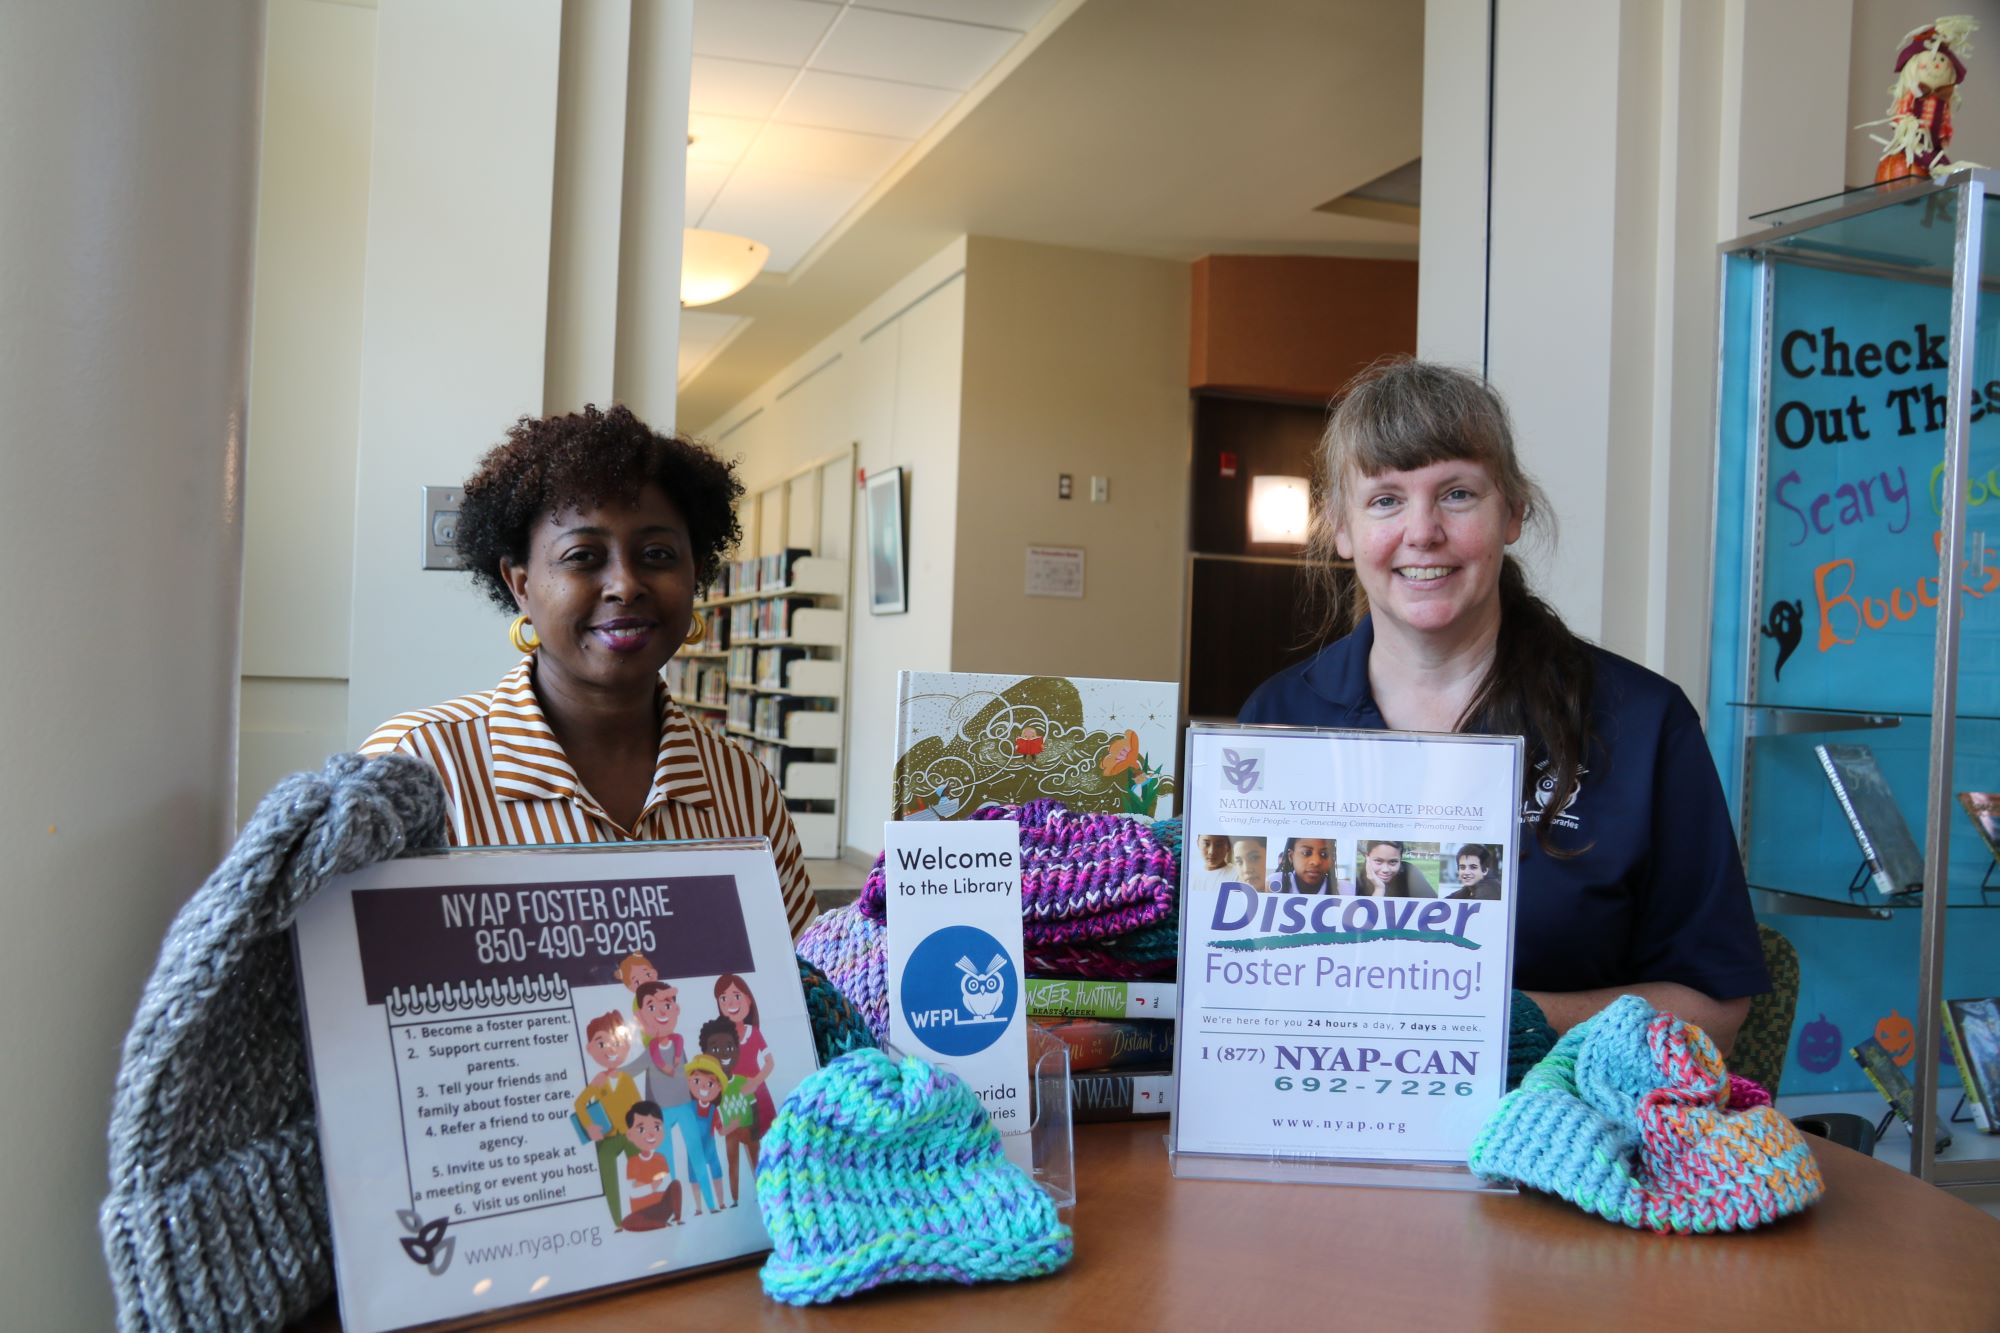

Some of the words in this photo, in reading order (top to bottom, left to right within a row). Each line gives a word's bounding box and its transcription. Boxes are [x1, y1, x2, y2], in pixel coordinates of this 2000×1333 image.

[1781, 324, 1948, 379] Check
[1775, 396, 1870, 449] Out
[1775, 465, 1911, 547] Scary
[1219, 798, 1285, 811] NATIONAL
[1289, 800, 1336, 812] YOUTH
[1341, 802, 1413, 815] ADVOCATE
[1417, 805, 1484, 817] PROGRAM
[1218, 815, 1247, 825] Caring
[1248, 816, 1261, 825] for
[1262, 817, 1290, 826] People
[1300, 818, 1347, 829] Connecting
[1349, 819, 1404, 829] Communities
[1413, 822, 1456, 832] Promoting
[1457, 823, 1482, 831] Peace
[897, 846, 1013, 870] Welcome
[899, 881, 916, 896] to
[921, 879, 948, 895] the
[954, 878, 1013, 897] Library
[441, 892, 511, 928] NYAP
[517, 888, 609, 925] FOSTER
[612, 885, 673, 919] CARE
[1210, 881, 1482, 939] Discover
[475, 921, 657, 964] 850-490-9295
[1205, 952, 1307, 986] Foster
[1316, 956, 1482, 1000] Parenting!
[1026, 982, 1073, 1009] NSTER
[405, 1029, 416, 1039] 1.
[421, 1023, 473, 1038] Become
[476, 1023, 484, 1032] a
[486, 1018, 523, 1031] foster
[527, 1014, 571, 1030] parent.
[911, 1008, 988, 1028] WFPL
[1202, 1015, 1232, 1025] We're
[1236, 1016, 1260, 1025] here
[1264, 1017, 1280, 1026] for
[1283, 1019, 1302, 1029] you
[1307, 1018, 1321, 1027] 24
[1325, 1019, 1358, 1029] hours
[1362, 1021, 1369, 1029] a
[1373, 1020, 1394, 1032] day,
[1399, 1022, 1406, 1030] 7
[1410, 1022, 1437, 1032] days
[1451, 1023, 1482, 1032] week.
[407, 1048, 420, 1059] 2.
[429, 1042, 480, 1059] Support
[484, 1037, 530, 1051] current
[533, 1032, 569, 1046] foster
[467, 1057, 519, 1075] parents.
[1201, 1046, 1209, 1060] 1
[1216, 1046, 1266, 1064] (877)
[1273, 1045, 1480, 1076] NYAP-CAN
[417, 1087, 428, 1098] 3.
[438, 1082, 462, 1096] Tell
[465, 1081, 494, 1096] your
[497, 1073, 541, 1089] friends
[544, 1069, 567, 1082] and
[974, 1083, 1016, 1101] orida
[418, 1103, 459, 1119] family
[463, 1099, 500, 1113] about
[504, 1093, 541, 1107] foster
[544, 1089, 575, 1101] care.
[425, 1126, 437, 1137] 4.
[440, 1121, 475, 1136] Refer
[479, 1121, 487, 1130] a
[490, 1113, 528, 1128] friend
[532, 1112, 545, 1123] to
[548, 1108, 569, 1120] our
[1272, 1117, 1407, 1133] www.nyap.org
[479, 1135, 528, 1153] agency.
[432, 1166, 444, 1178] 5.
[447, 1160, 485, 1175] Invite
[489, 1158, 504, 1169] us
[507, 1154, 520, 1165] to
[523, 1148, 561, 1165] speak
[564, 1146, 576, 1157] at
[415, 1192, 422, 1201] a
[426, 1181, 481, 1200] meeting
[484, 1179, 497, 1189] or
[502, 1172, 537, 1187] event
[541, 1167, 564, 1183] you
[567, 1162, 597, 1176] host.
[454, 1204, 466, 1216] 6.
[473, 1197, 500, 1212] Visit
[505, 1196, 519, 1206] us
[523, 1186, 567, 1203] online!
[464, 1225, 602, 1265] www.nyap.org
